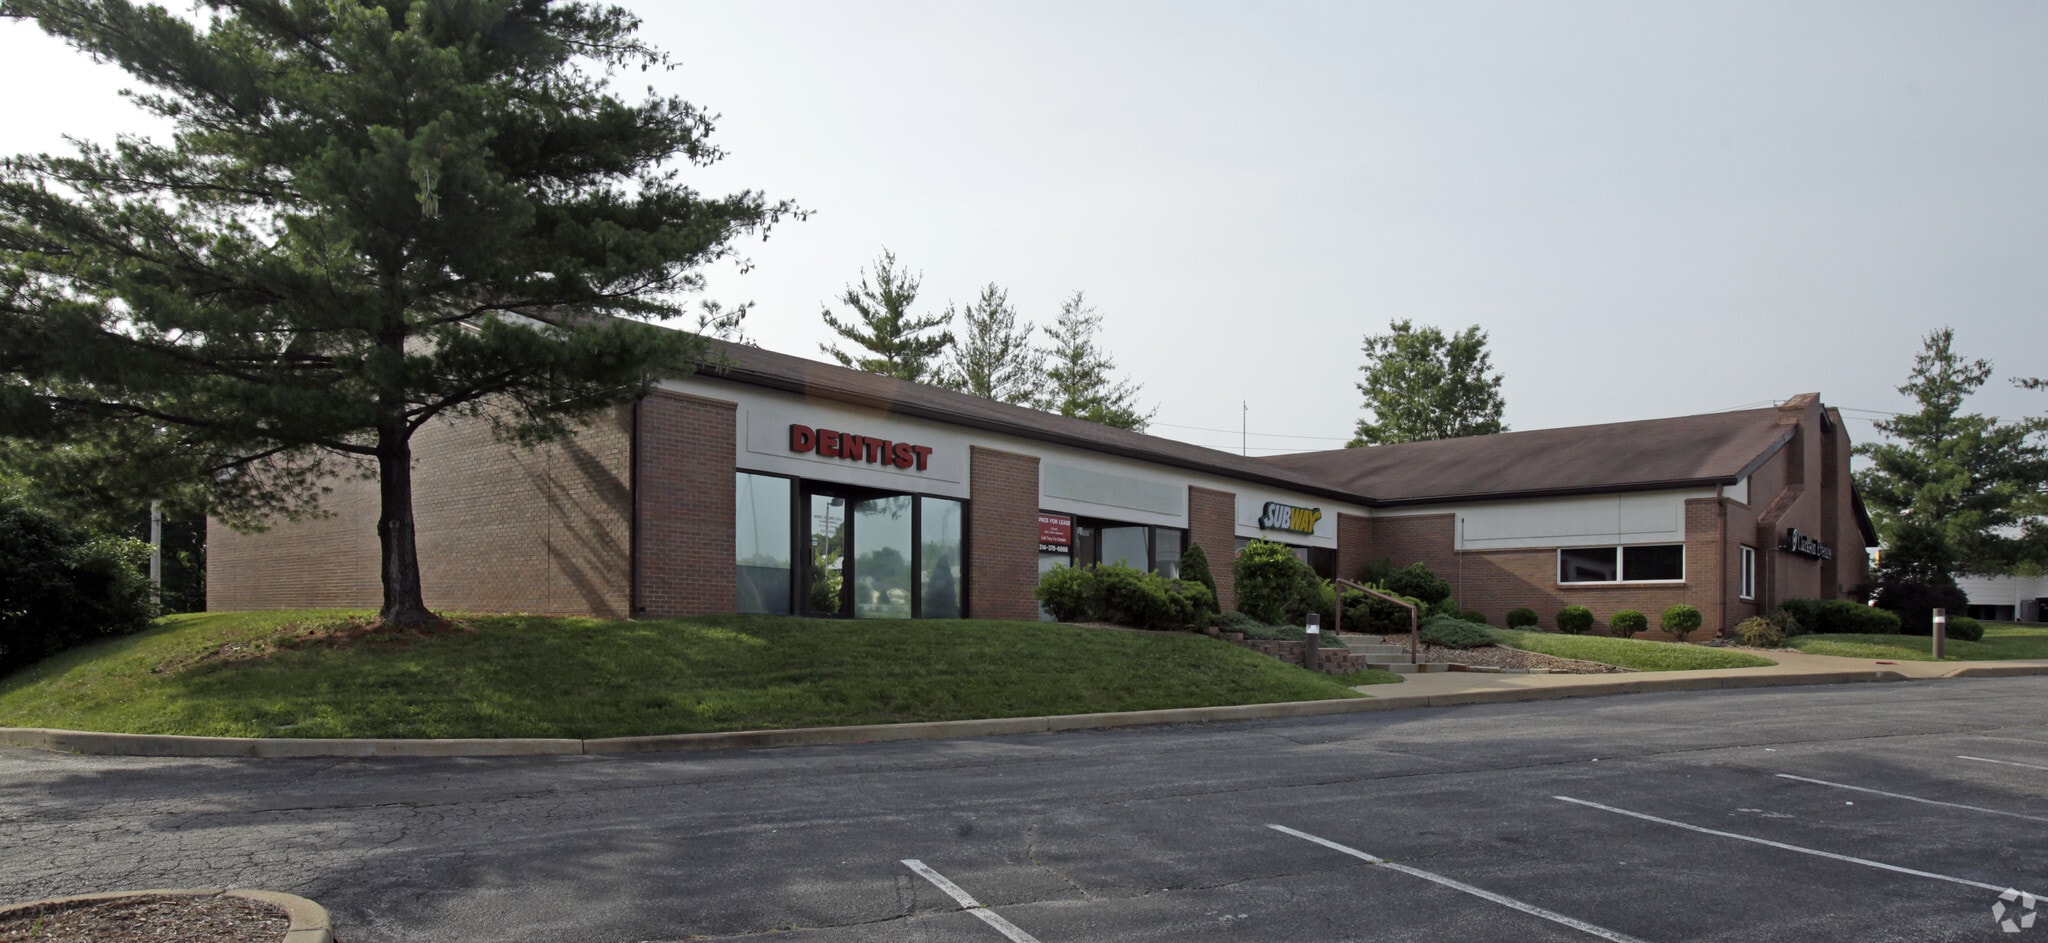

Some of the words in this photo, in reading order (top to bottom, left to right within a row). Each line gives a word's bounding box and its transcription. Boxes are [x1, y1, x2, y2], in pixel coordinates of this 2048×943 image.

[789, 423, 933, 471] DENTIST
[1059, 519, 1071, 527] LEASE
[1262, 502, 1322, 533] SUBWAY
